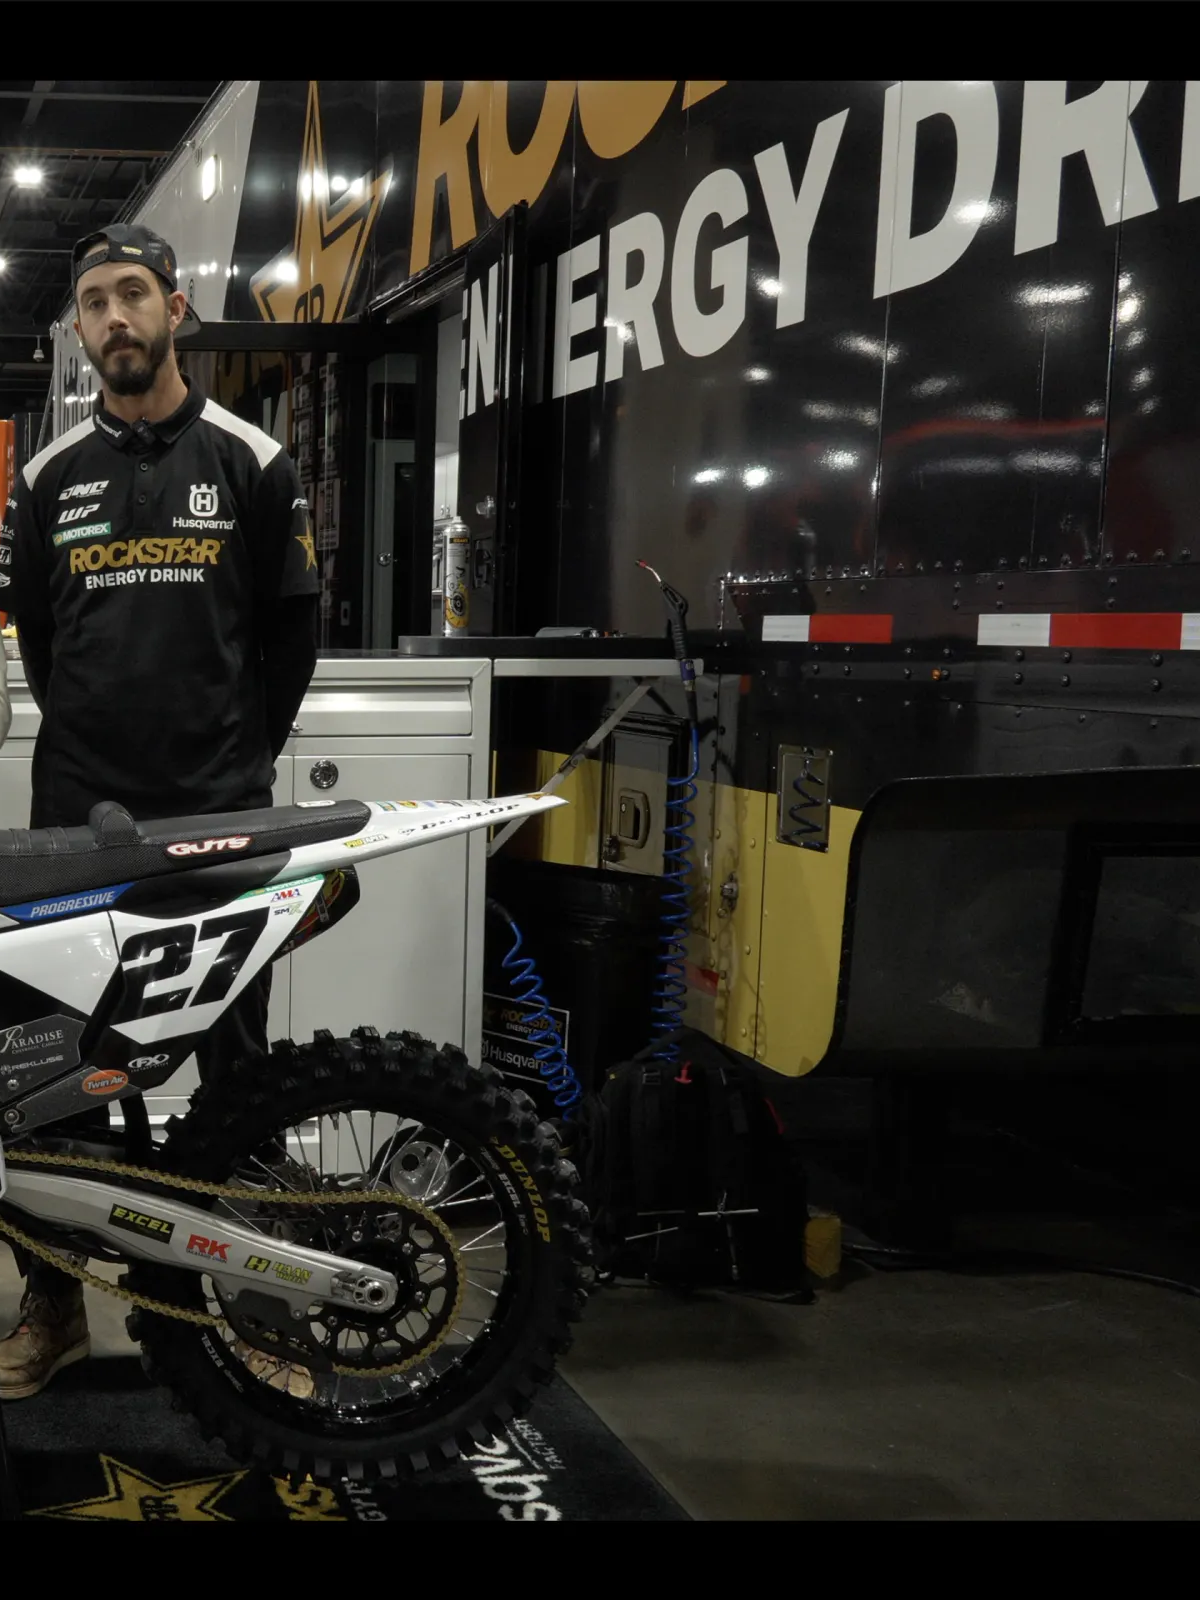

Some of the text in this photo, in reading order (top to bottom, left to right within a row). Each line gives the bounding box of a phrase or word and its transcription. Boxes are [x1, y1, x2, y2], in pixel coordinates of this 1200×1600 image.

[57, 503, 101, 524] WP
[173, 516, 234, 531] Husqvarna
[62, 523, 109, 539] MOTOREX
[69, 537, 222, 575] ROCKSTAR
[85, 568, 205, 590] ENERGY DRINK
[167, 836, 250, 857] GUTS
[30, 890, 116, 918] PROGRESSIVE
[270, 888, 302, 903] AMA
[120, 905, 271, 1017] 27
[489, 1044, 549, 1070] Husqvarn
[87, 1078, 110, 1091] Twin
[494, 1144, 551, 1244] DUNLOP
[112, 1206, 171, 1234] EXCEL
[186, 1233, 232, 1261] RK
[271, 1261, 314, 1280] HAAN
